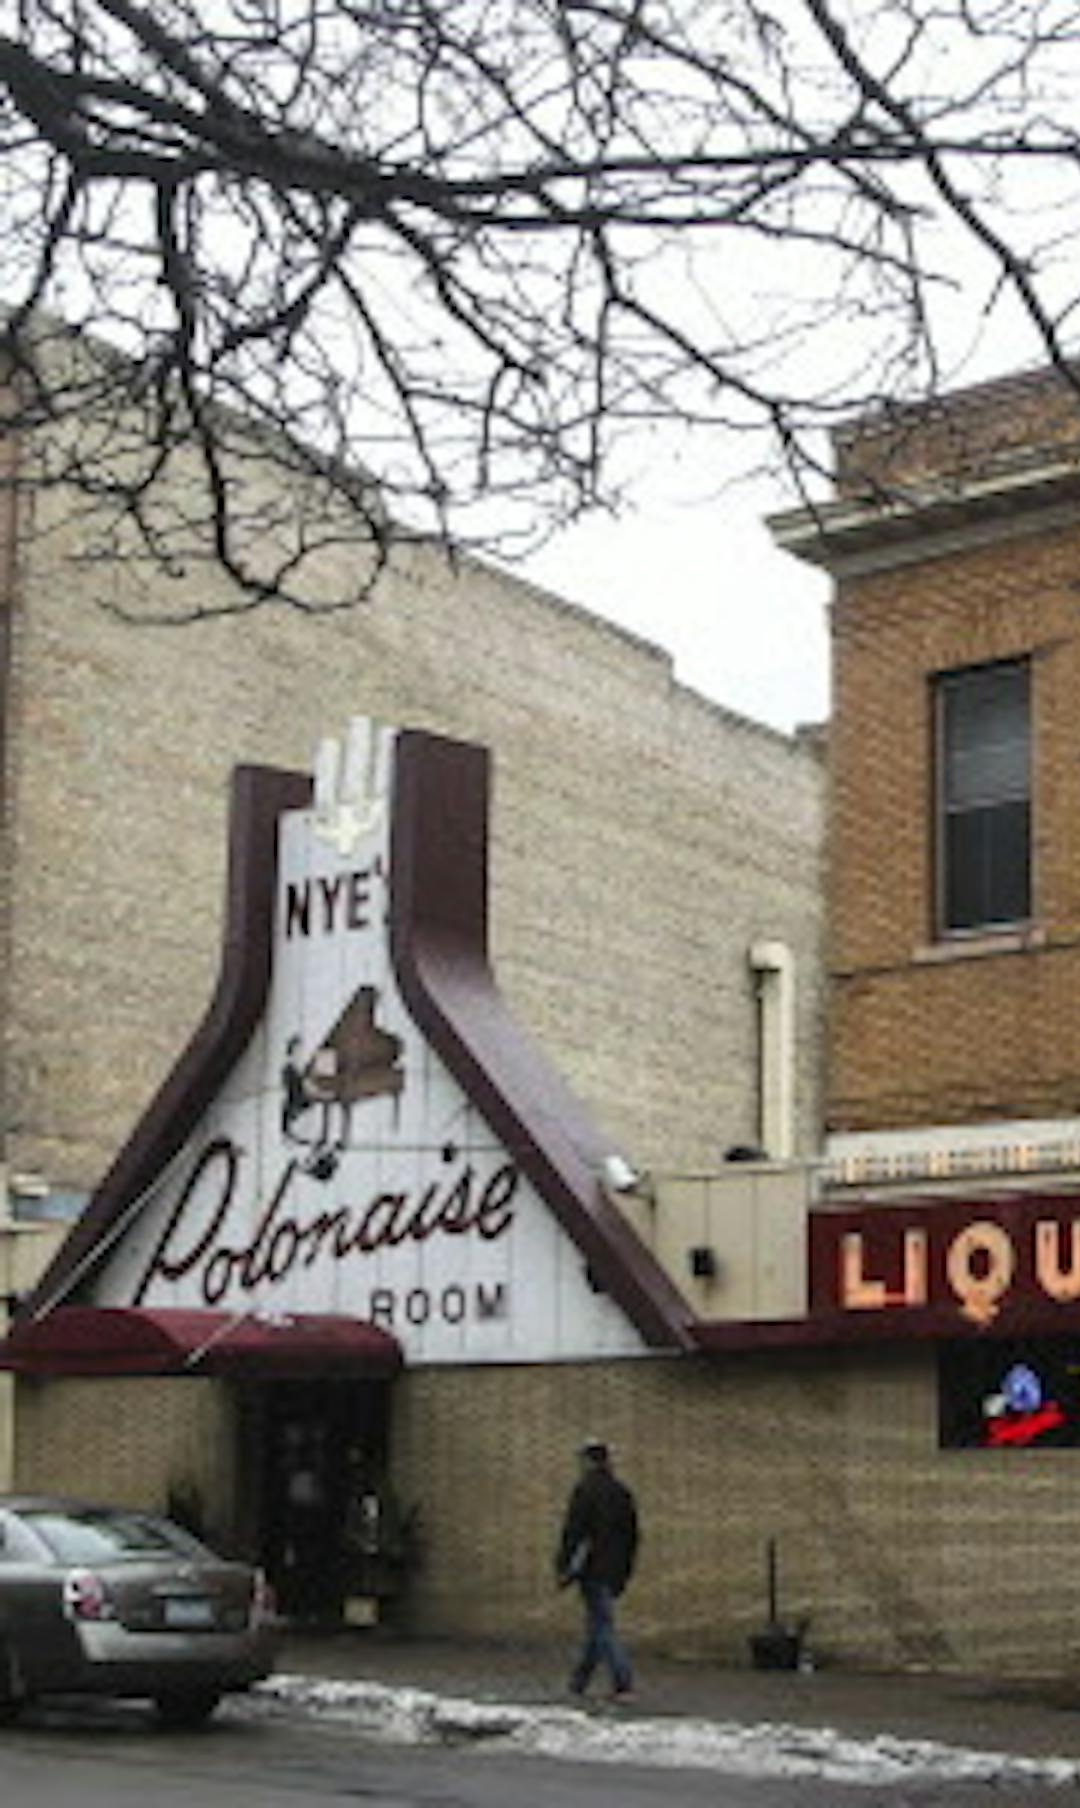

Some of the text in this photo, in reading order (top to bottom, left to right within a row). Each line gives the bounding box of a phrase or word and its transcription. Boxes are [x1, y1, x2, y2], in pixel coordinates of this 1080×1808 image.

[286, 854, 391, 940] NYE'
[132, 1136, 518, 1306] Polonaise
[370, 1282, 507, 1326] ROOM
